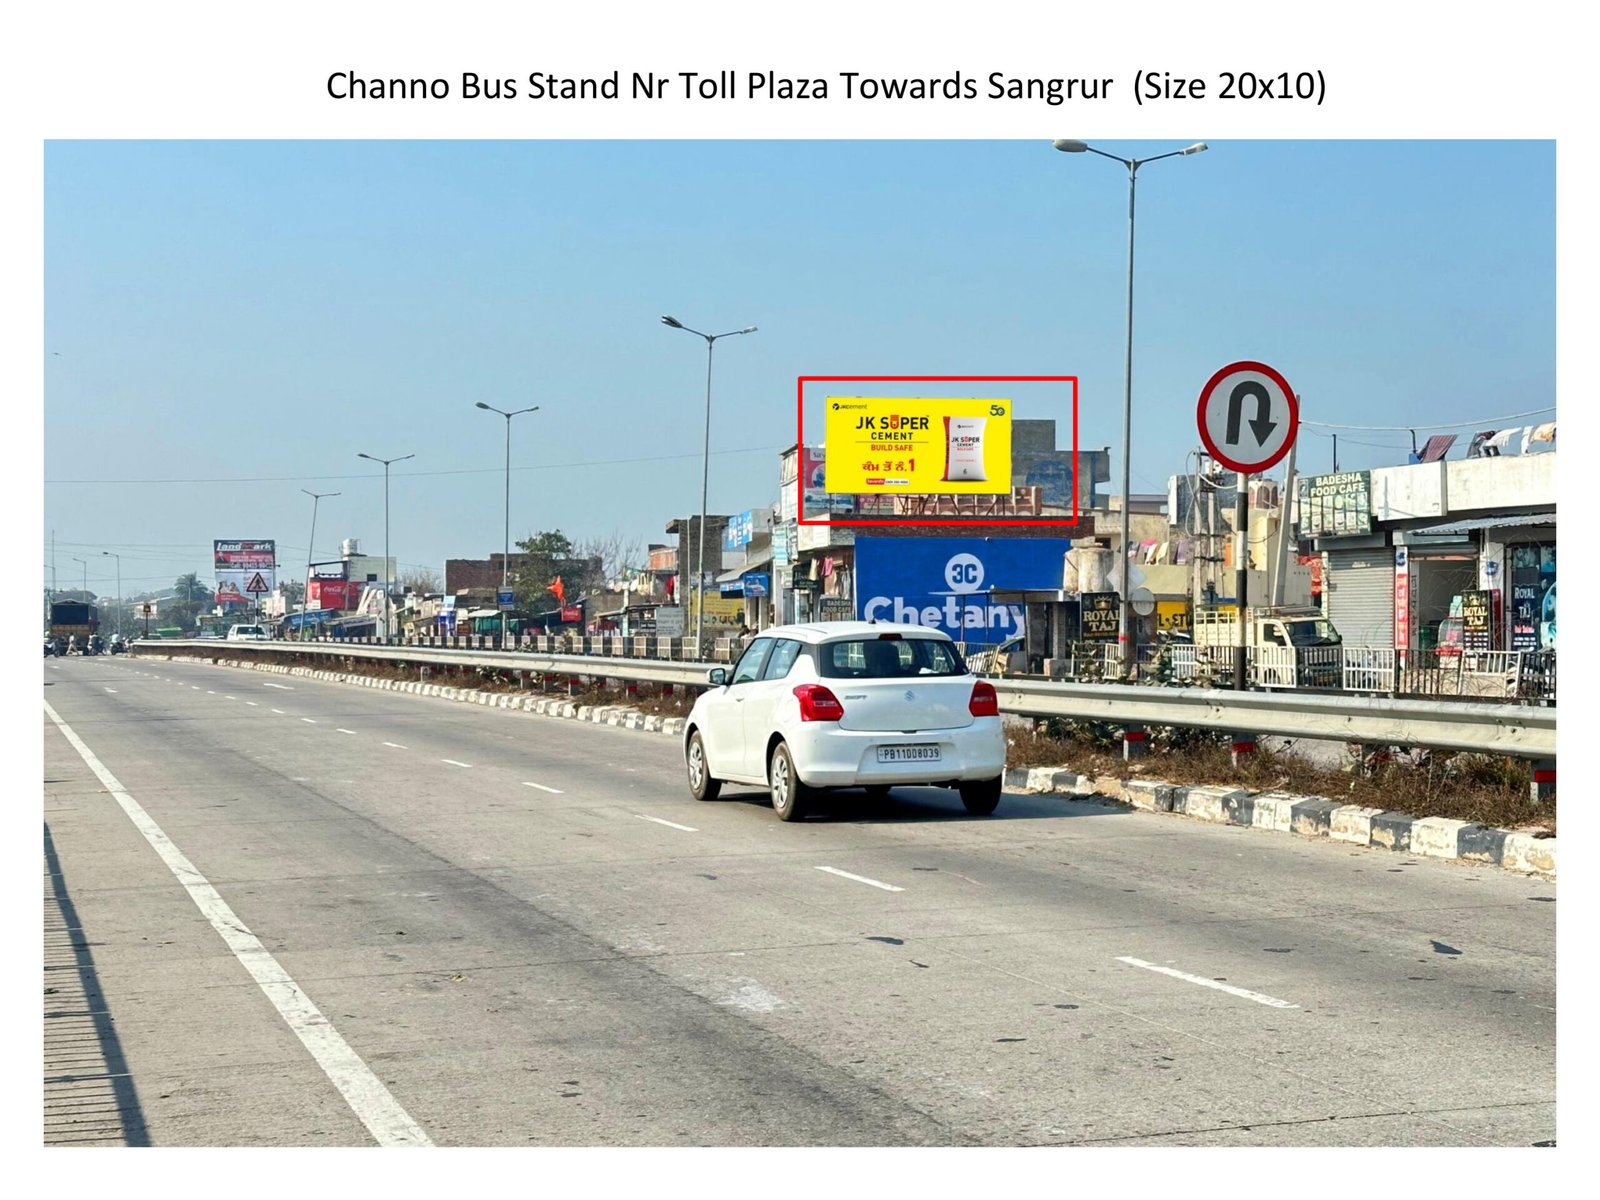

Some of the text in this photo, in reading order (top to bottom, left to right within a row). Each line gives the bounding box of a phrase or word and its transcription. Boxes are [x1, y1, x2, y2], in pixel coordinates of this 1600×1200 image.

[856, 415, 929, 429] JK SUPER
[871, 432, 913, 440] CEMENT
[1315, 472, 1362, 487] BADESHA
[1310, 482, 1365, 497] FOOD CAFE
[952, 563, 977, 584] 3C
[1514, 587, 1535, 599] ROYAL
[1463, 606, 1487, 616] ROYAL
[1088, 621, 1116, 632] TAJ
[1467, 616, 1484, 626] TAJ
